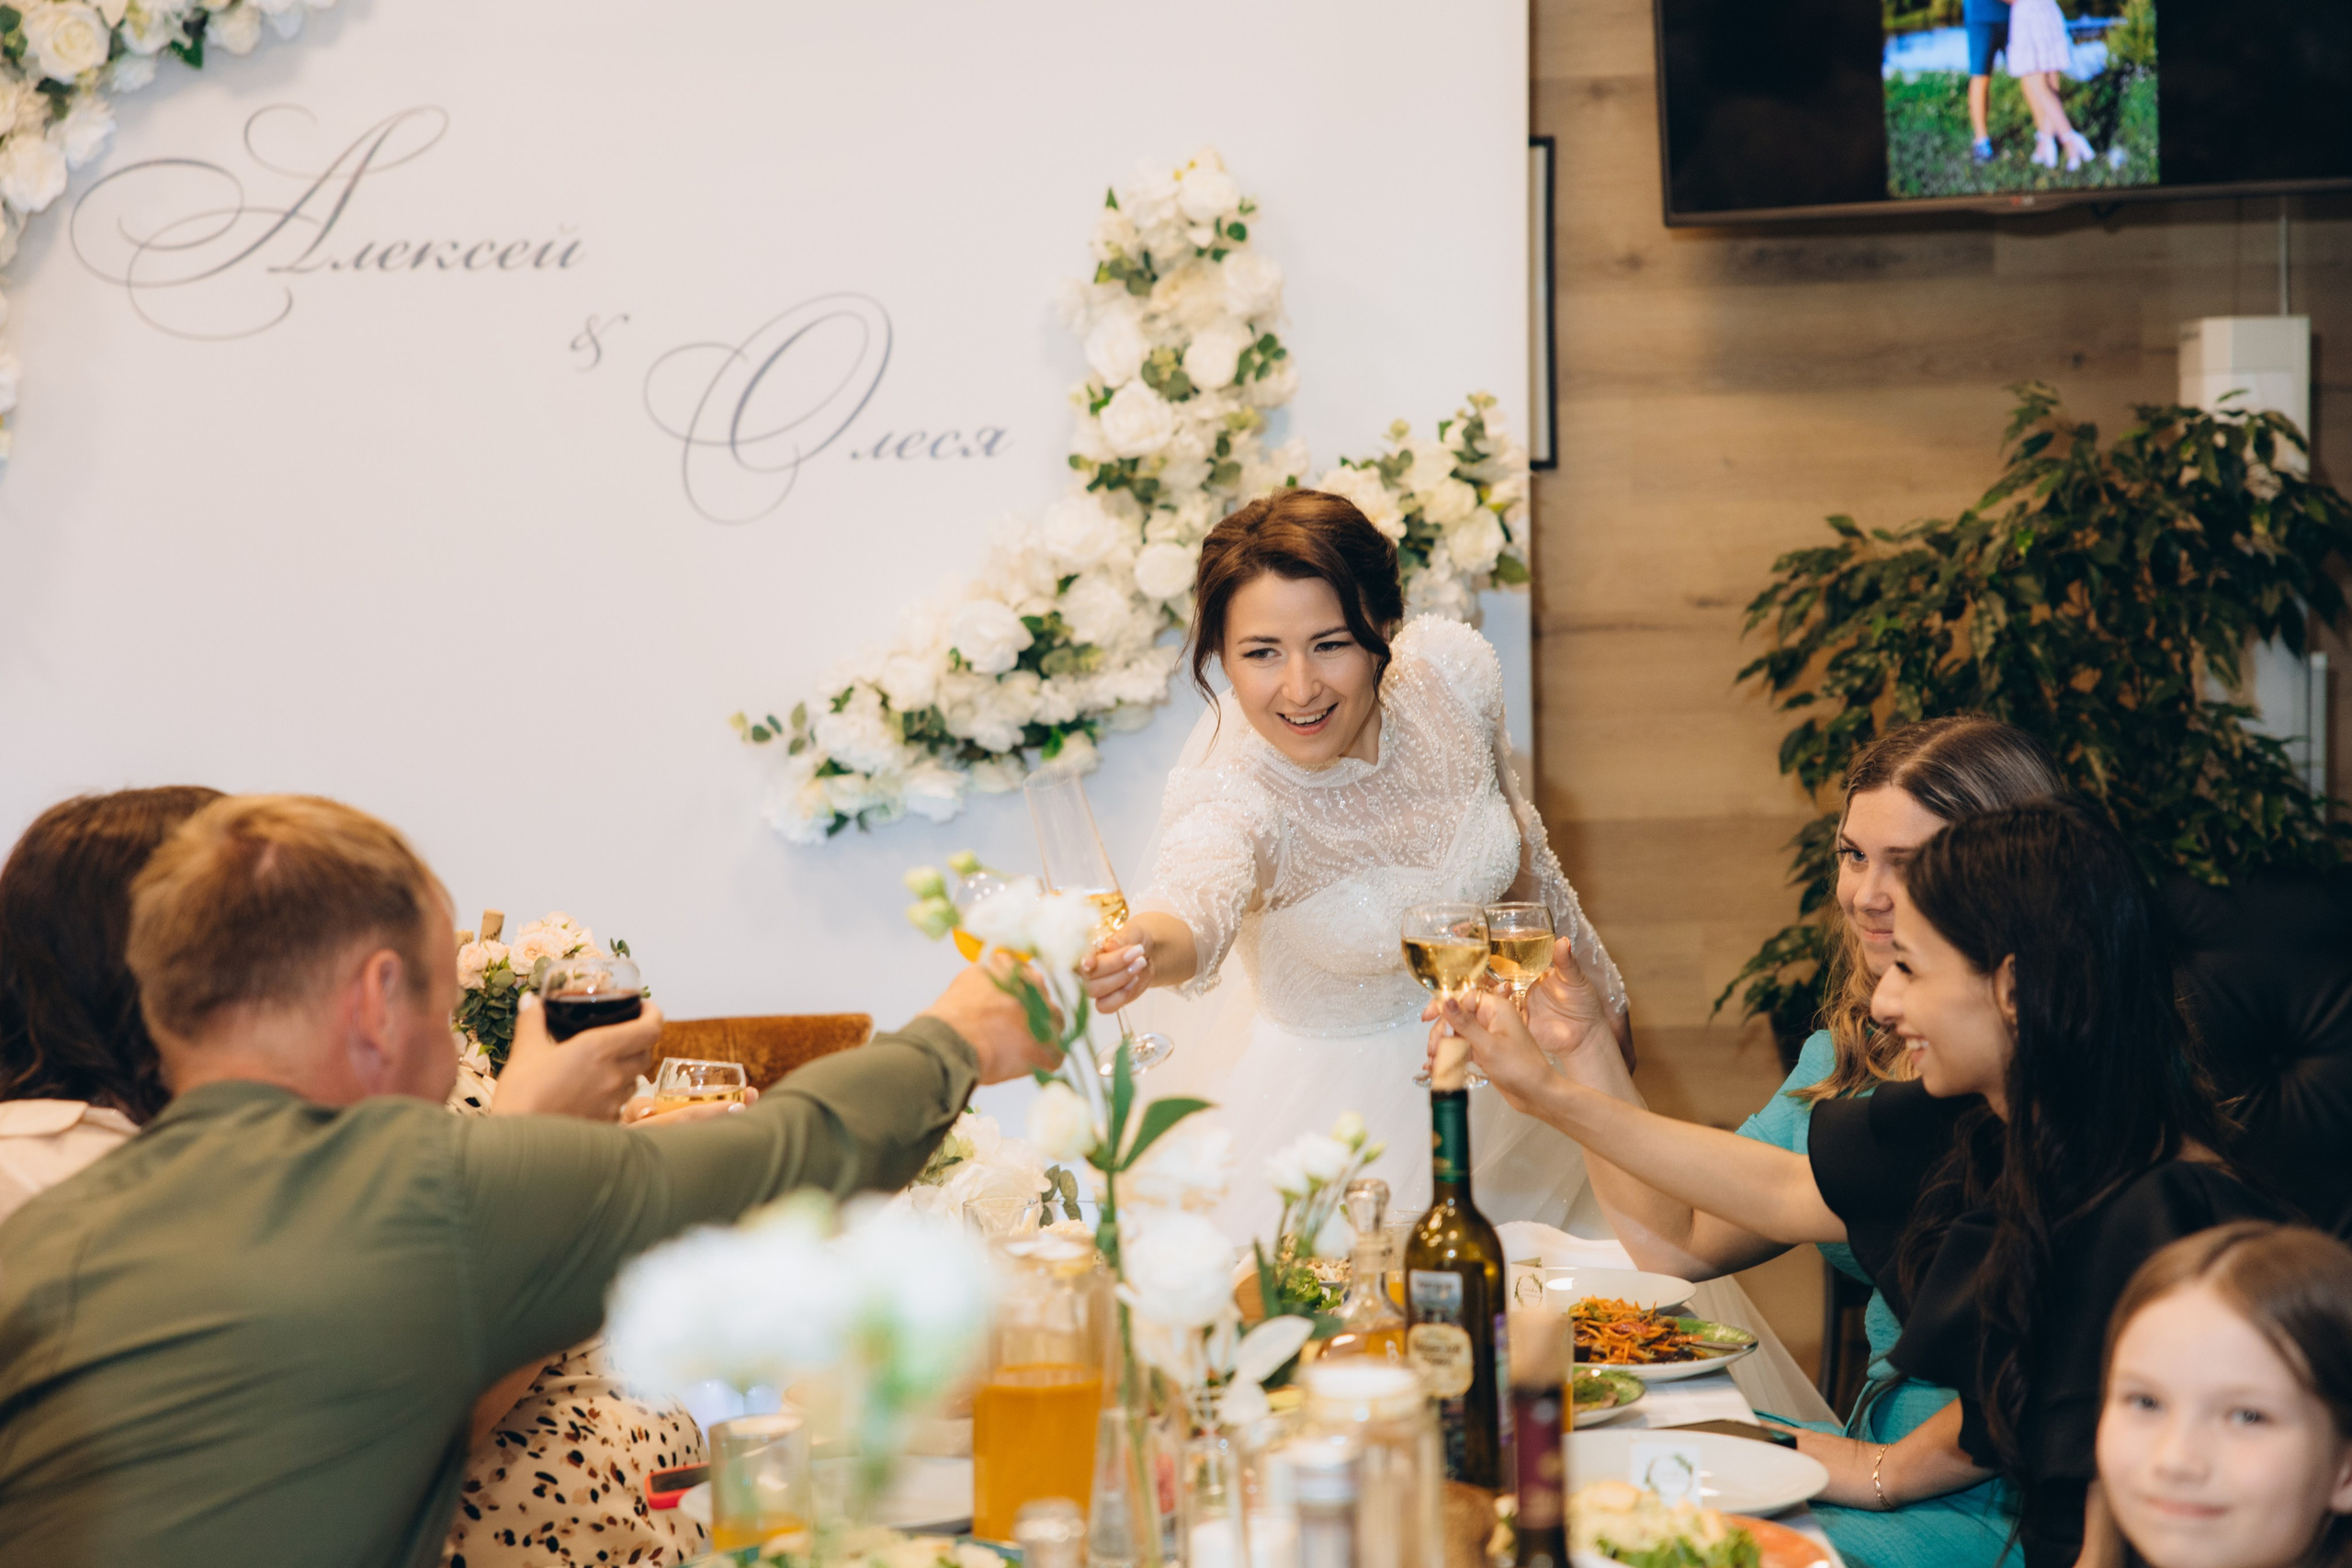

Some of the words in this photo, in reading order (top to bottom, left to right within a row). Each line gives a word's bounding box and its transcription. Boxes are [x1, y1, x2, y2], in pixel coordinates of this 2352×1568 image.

[70, 103, 586, 342] Алексей
[568, 312, 631, 373] &
[642, 291, 1012, 526] Олеся
